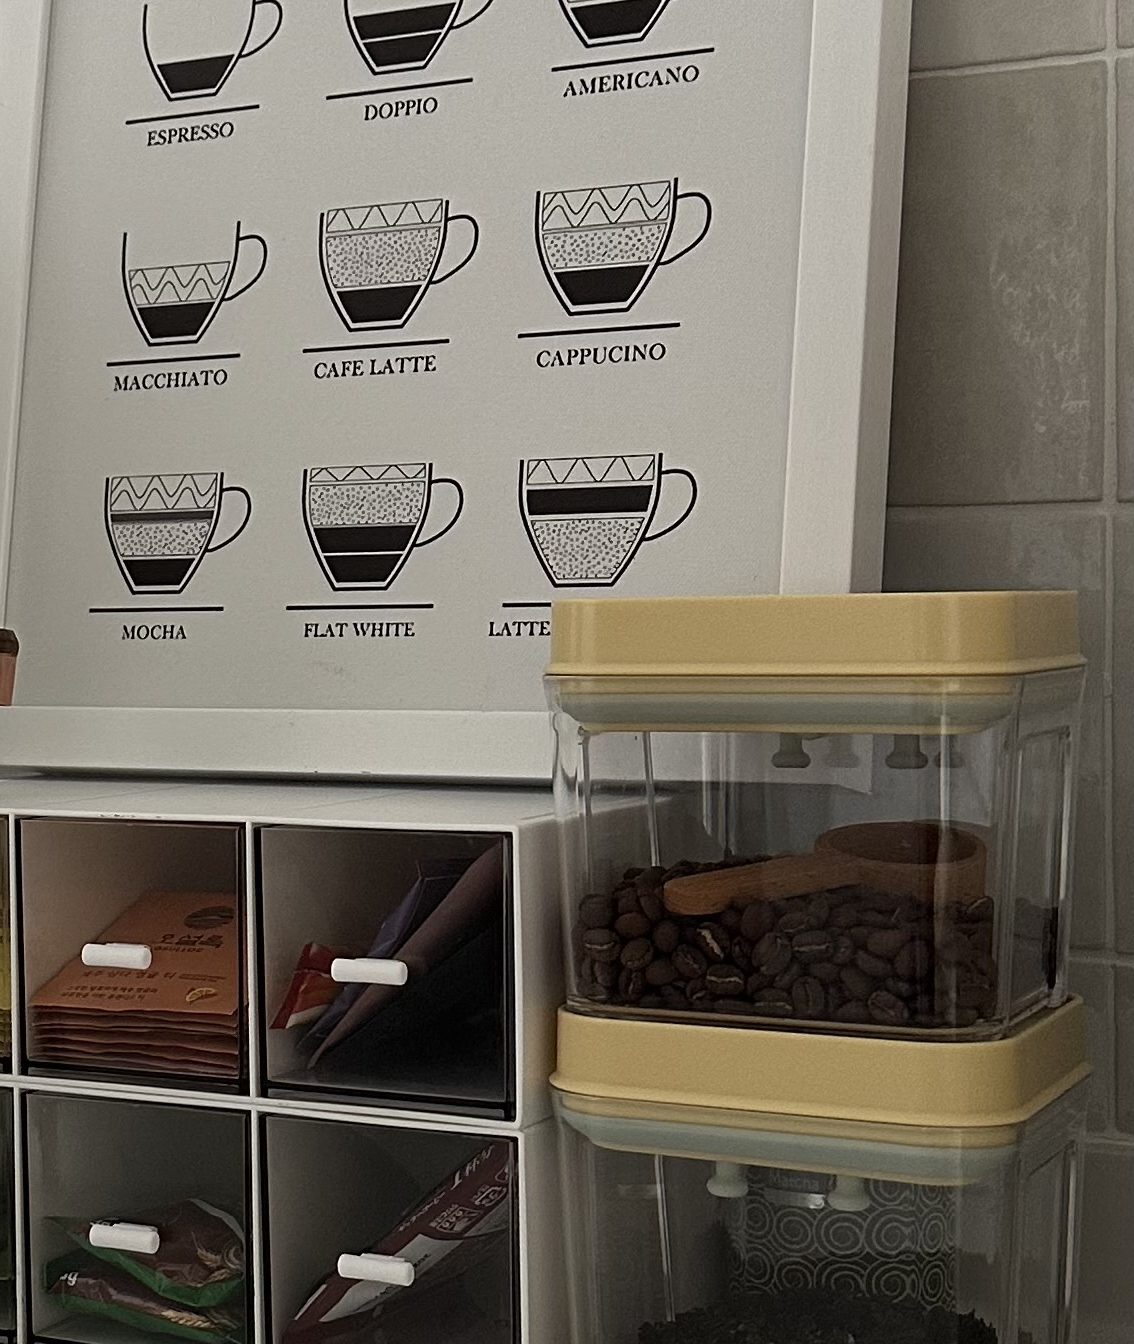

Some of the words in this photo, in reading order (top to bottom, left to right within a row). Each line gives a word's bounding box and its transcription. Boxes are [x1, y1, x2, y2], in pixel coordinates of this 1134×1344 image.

[563, 64, 700, 98] AMERICANO
[364, 97, 437, 121] DOPPIO
[147, 121, 234, 147] ESPRESSO
[537, 343, 665, 367] CAPPUCINO
[314, 360, 364, 379] CAFE
[370, 355, 436, 375] LATTE
[114, 369, 227, 391] MACCHIATO
[122, 625, 186, 640] MOCHA
[304, 623, 348, 637] FLAT
[353, 622, 415, 637] WHITE
[489, 621, 550, 636] LATTE
[769, 1170, 819, 1189] Matcha
